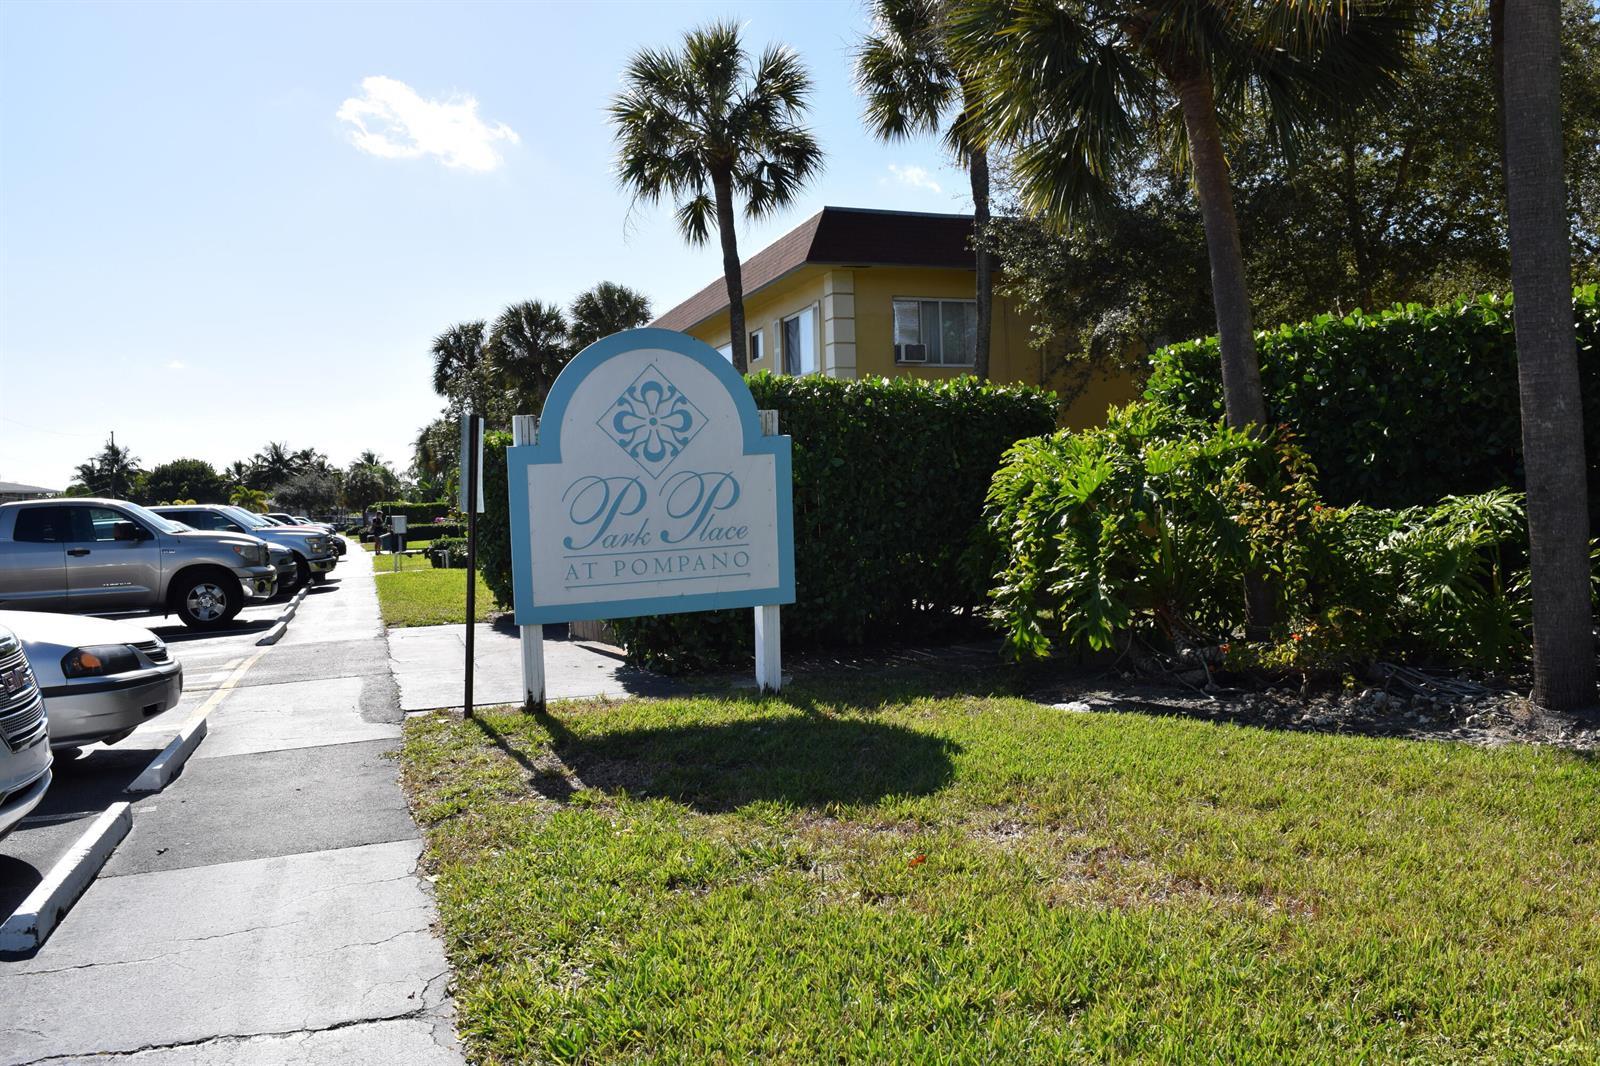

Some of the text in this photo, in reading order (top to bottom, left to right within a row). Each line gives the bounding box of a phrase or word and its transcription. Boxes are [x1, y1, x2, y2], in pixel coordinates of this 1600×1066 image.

[561, 470, 749, 550] Park Place
[564, 551, 750, 581] AT POMPANO
